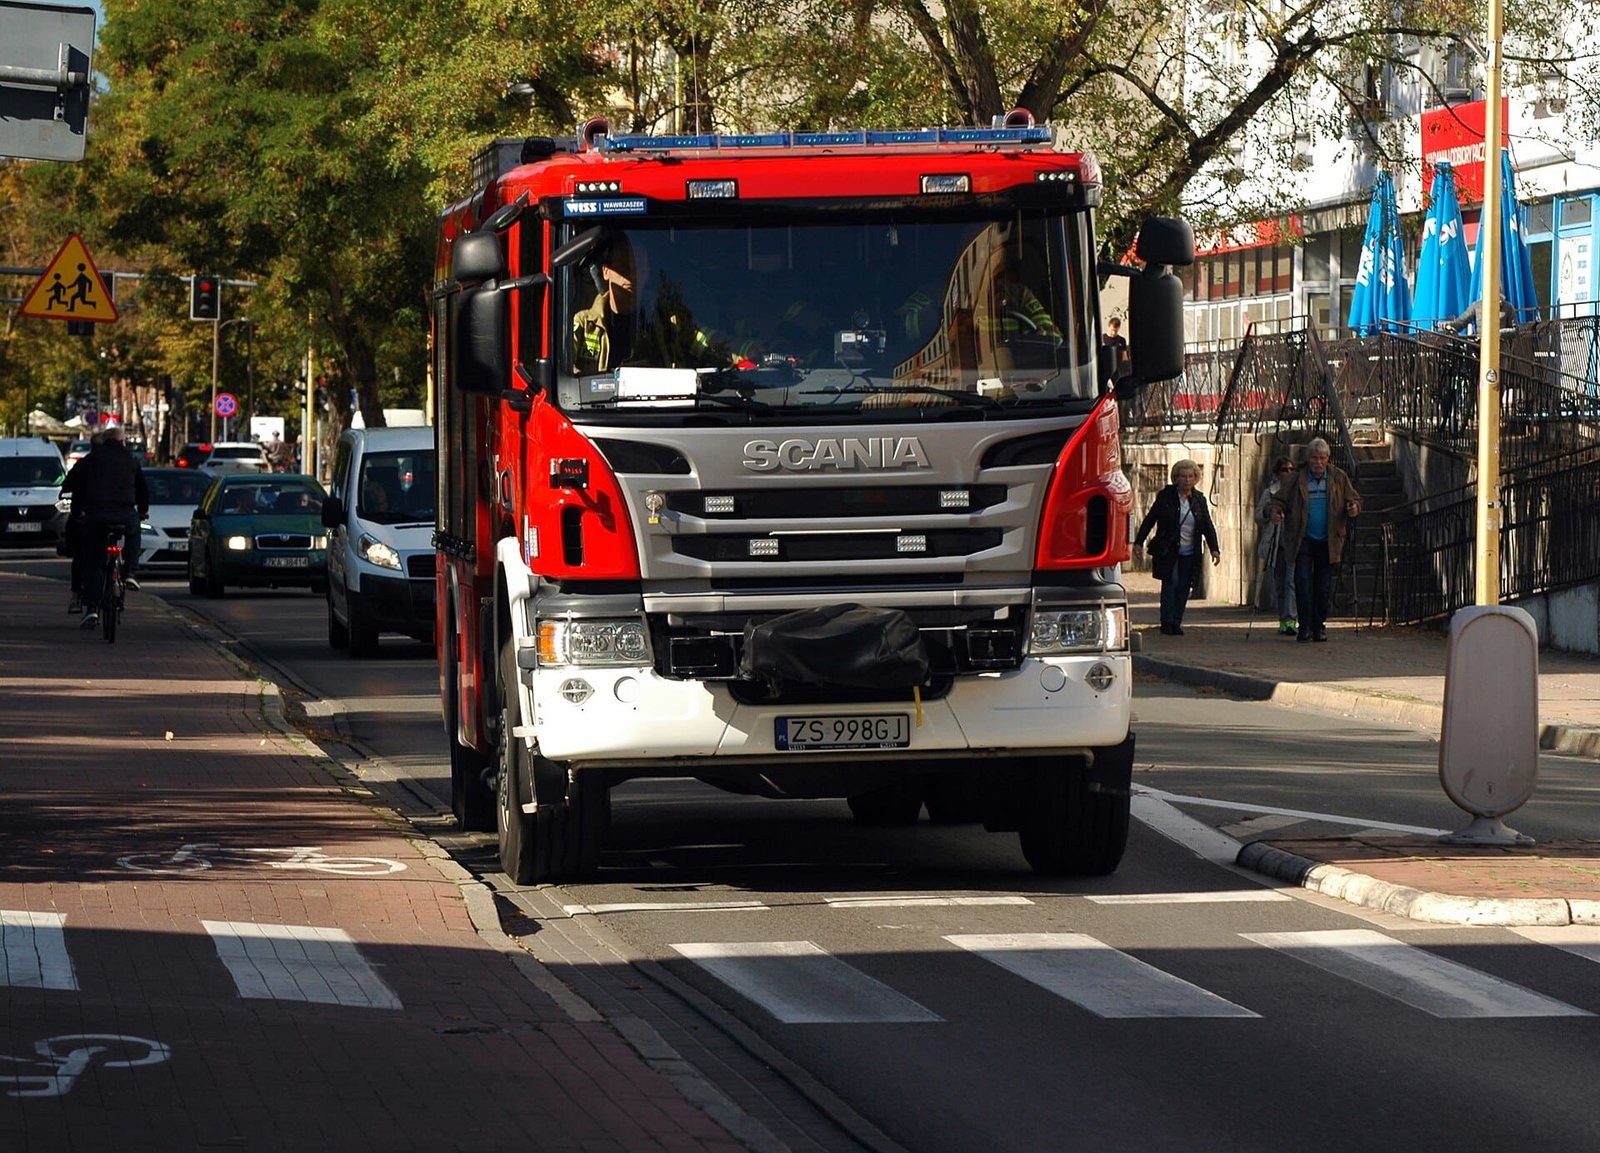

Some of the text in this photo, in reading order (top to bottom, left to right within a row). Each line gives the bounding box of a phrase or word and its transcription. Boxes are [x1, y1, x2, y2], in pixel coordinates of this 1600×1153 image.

[1472, 142, 1485, 162] PACZ
[566, 203, 597, 213] WISS
[742, 437, 932, 471] SCANIA
[791, 718, 901, 742] ZS 998GJ
